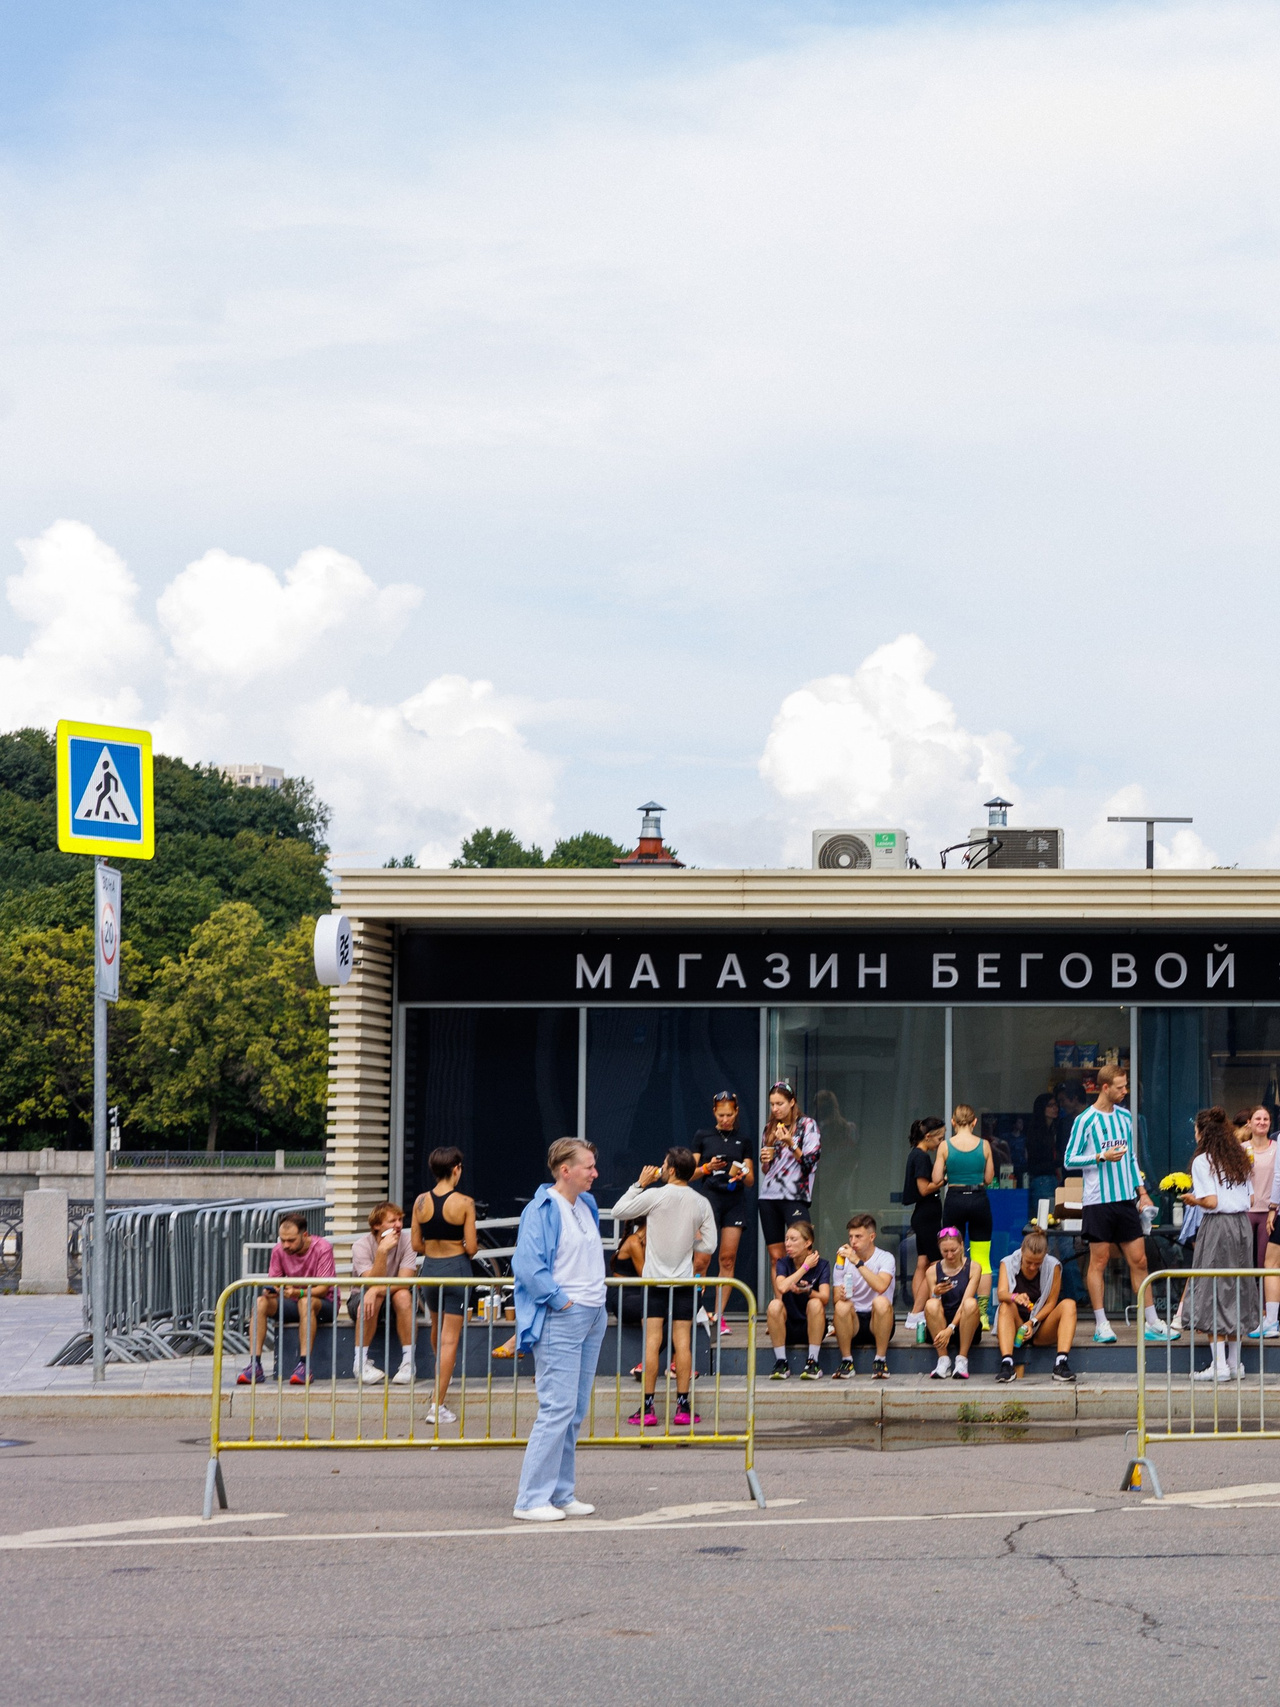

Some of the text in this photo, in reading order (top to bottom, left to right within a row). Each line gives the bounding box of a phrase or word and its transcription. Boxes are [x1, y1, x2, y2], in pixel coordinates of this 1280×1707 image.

[104, 920, 114, 944] 20
[576, 953, 887, 989] МАГАЗИН
[932, 943, 1235, 989] БЕГОВОЙ
